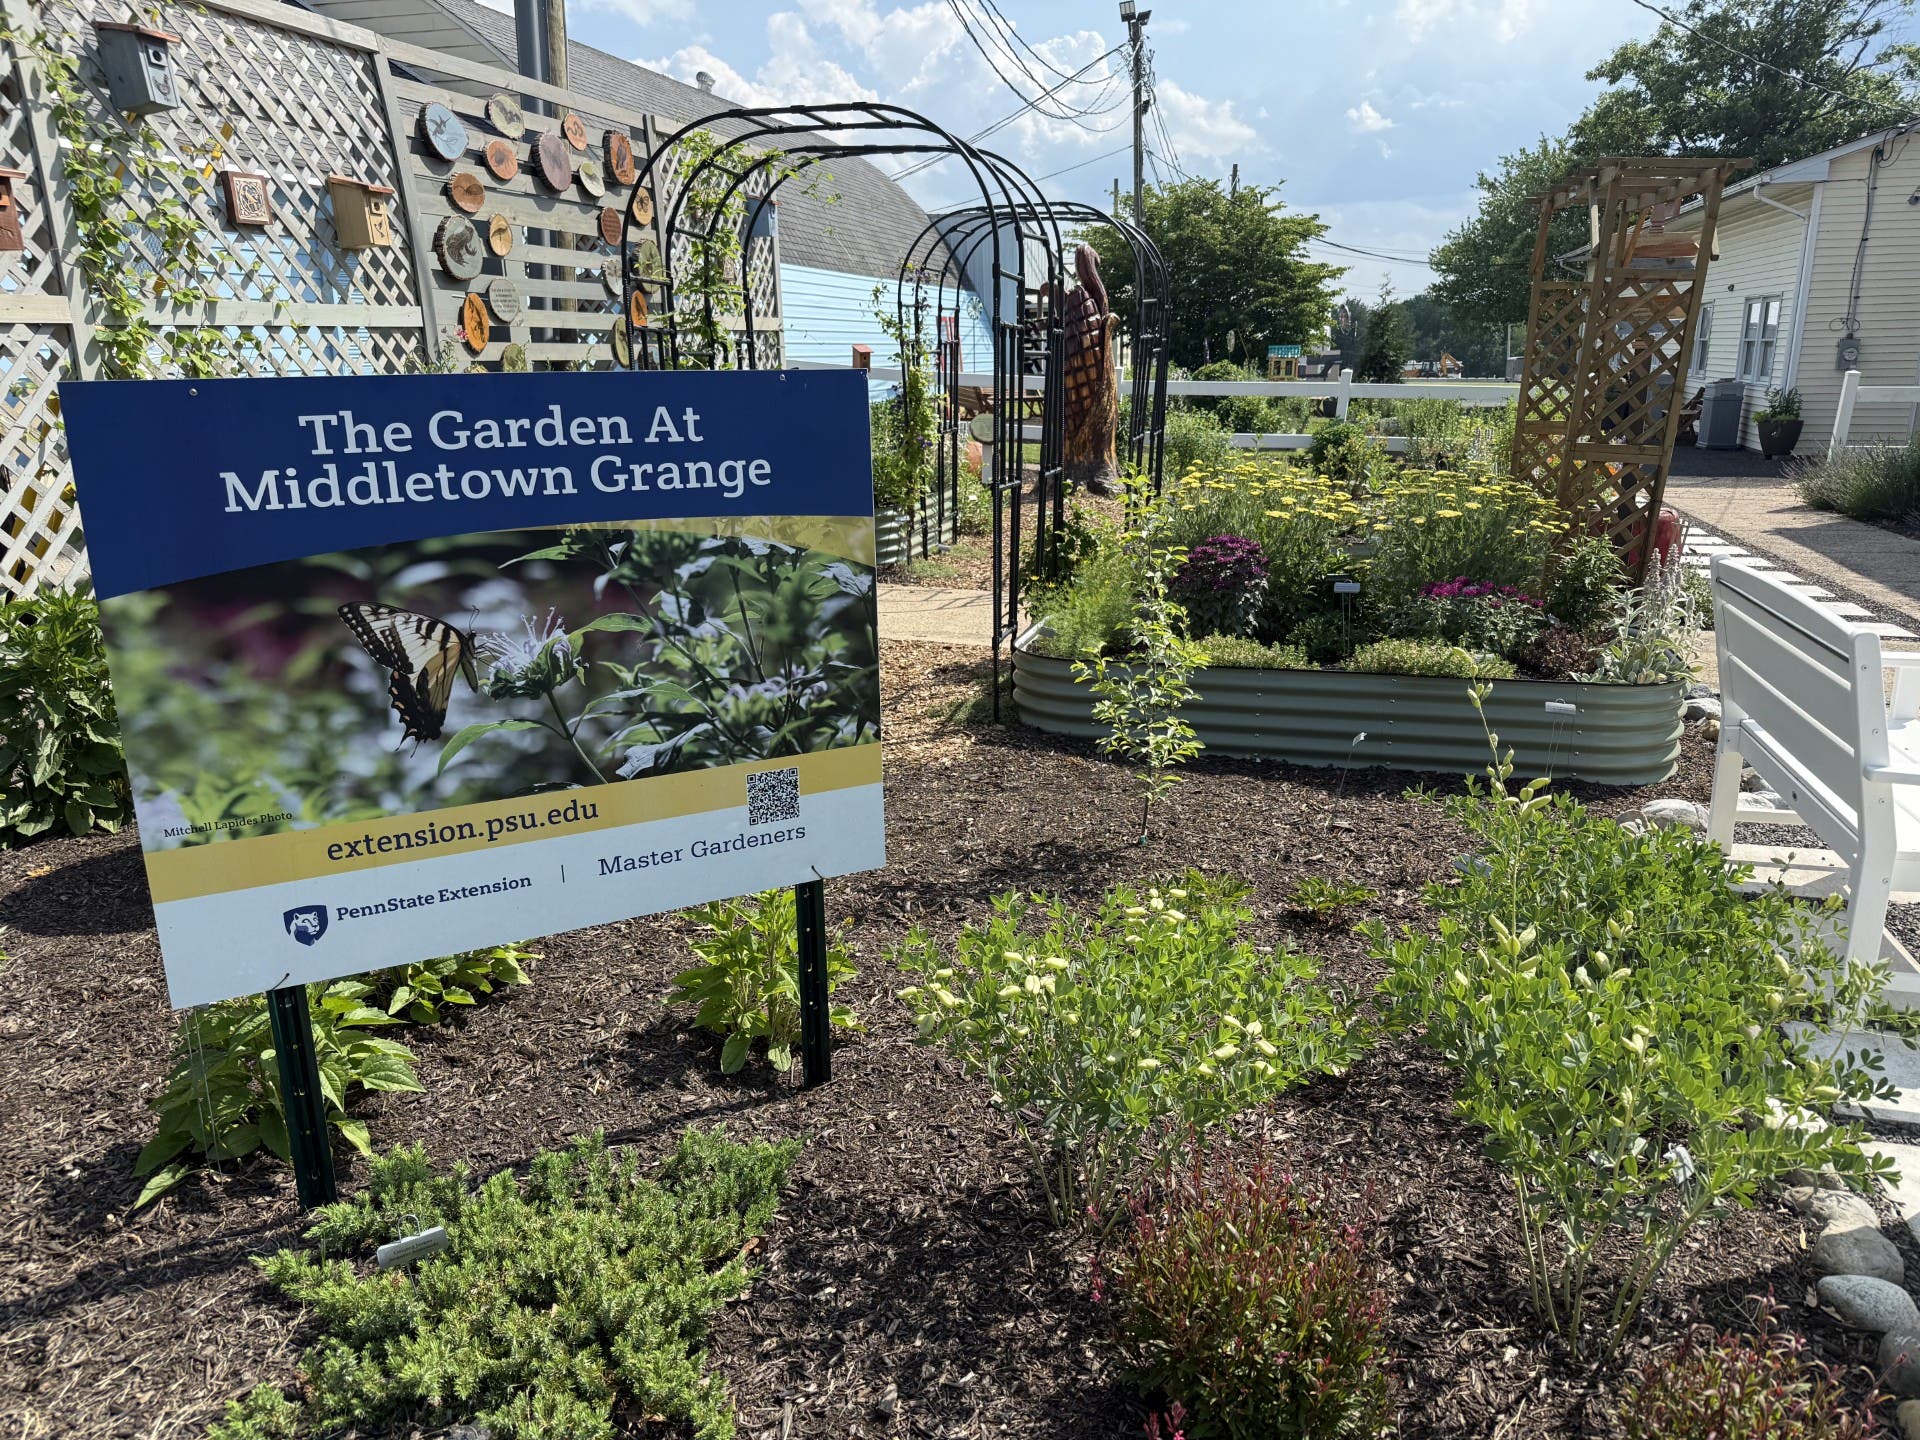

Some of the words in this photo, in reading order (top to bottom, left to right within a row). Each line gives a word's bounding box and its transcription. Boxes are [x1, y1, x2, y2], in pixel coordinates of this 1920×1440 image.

[298, 410, 413, 455] The
[428, 404, 633, 450] Garden
[644, 406, 704, 443] At
[219, 460, 578, 513] Middletown
[590, 455, 772, 498] Grange
[164, 821, 212, 837] Mitchell
[215, 816, 258, 831] Lapides
[261, 812, 293, 823] Photo
[327, 798, 599, 861] extension.psu.edu
[597, 849, 684, 876] Master
[690, 826, 807, 858] Gardeners
[335, 894, 435, 921] PennState
[437, 876, 533, 903] Extension
